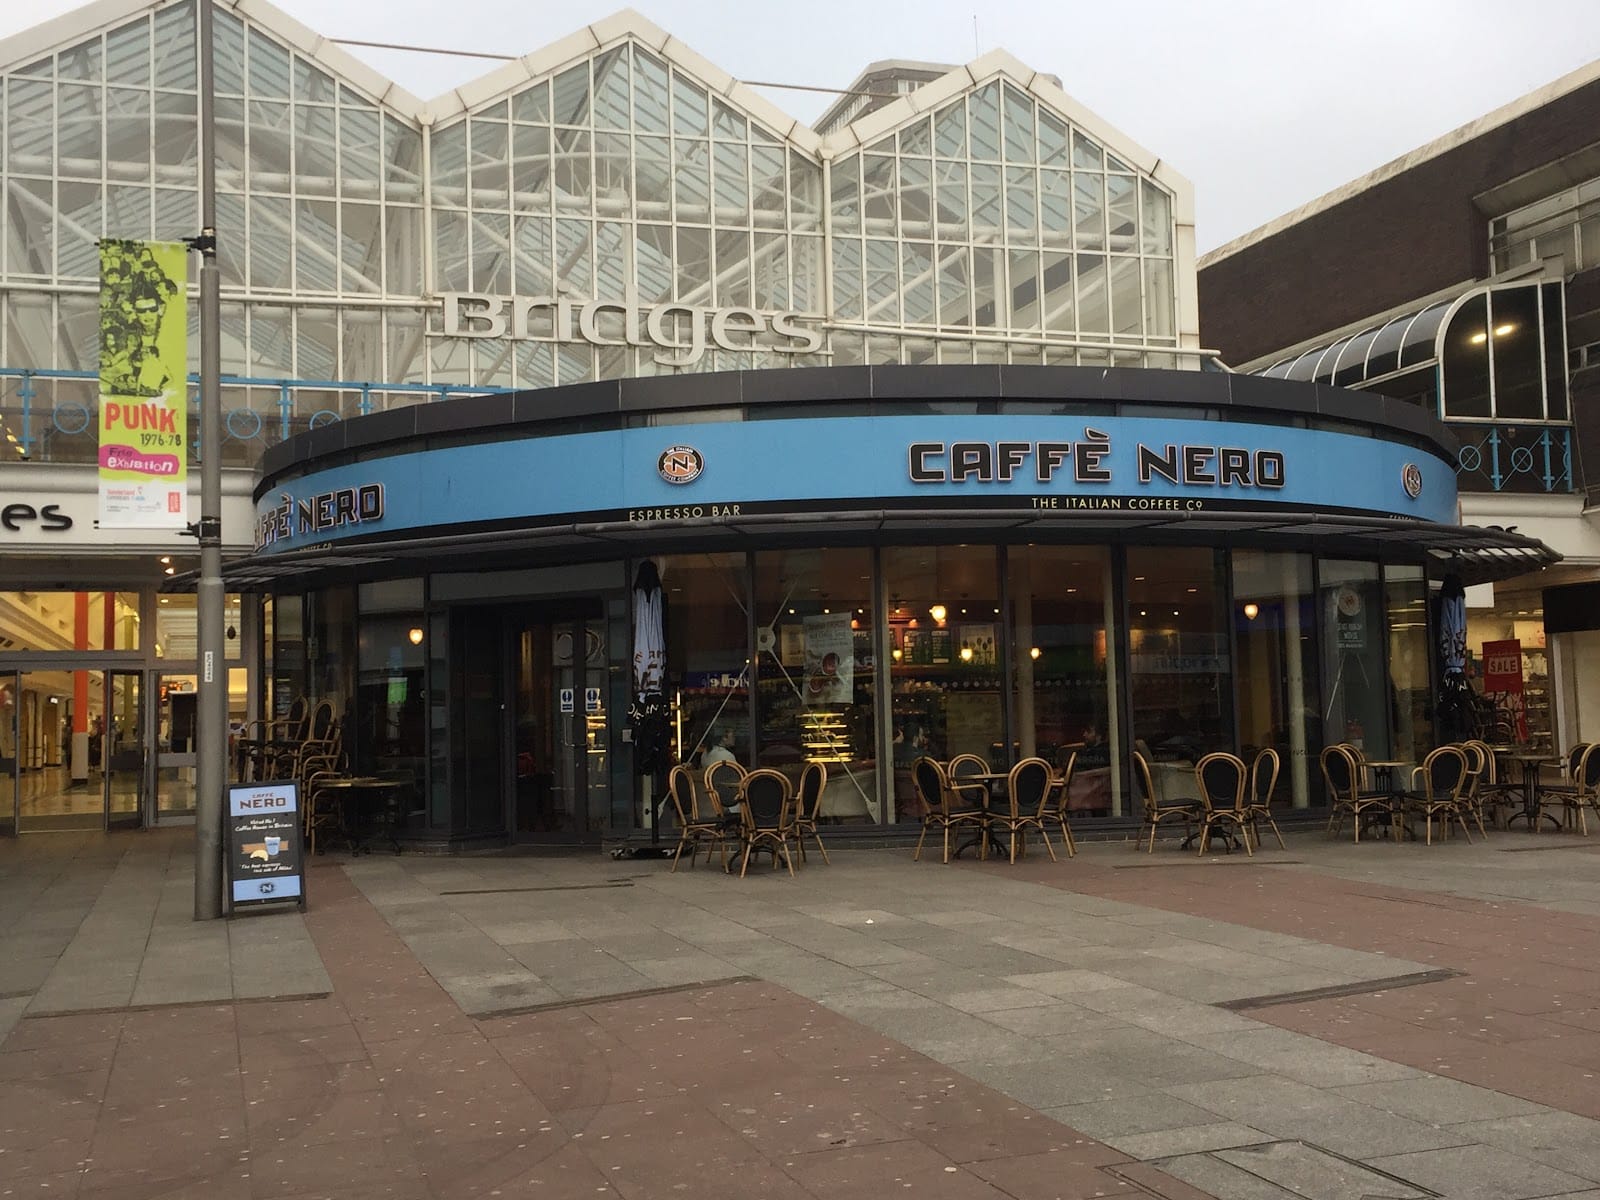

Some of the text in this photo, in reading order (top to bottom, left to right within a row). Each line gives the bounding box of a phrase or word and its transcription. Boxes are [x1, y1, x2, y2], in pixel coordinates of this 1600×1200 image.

[441, 282, 822, 366] Bridges
[104, 402, 176, 432] PUNK
[907, 426, 1287, 489] CAFFÈ NERO
[298, 482, 384, 533] NERO
[628, 504, 741, 521] ESPRESSO BAR
[1032, 497, 1058, 509] THE
[1065, 498, 1121, 510] ITALIAN
[1128, 499, 1180, 510] COFFEE
[1489, 660, 1518, 674] SALE
[240, 797, 286, 809] NERO
